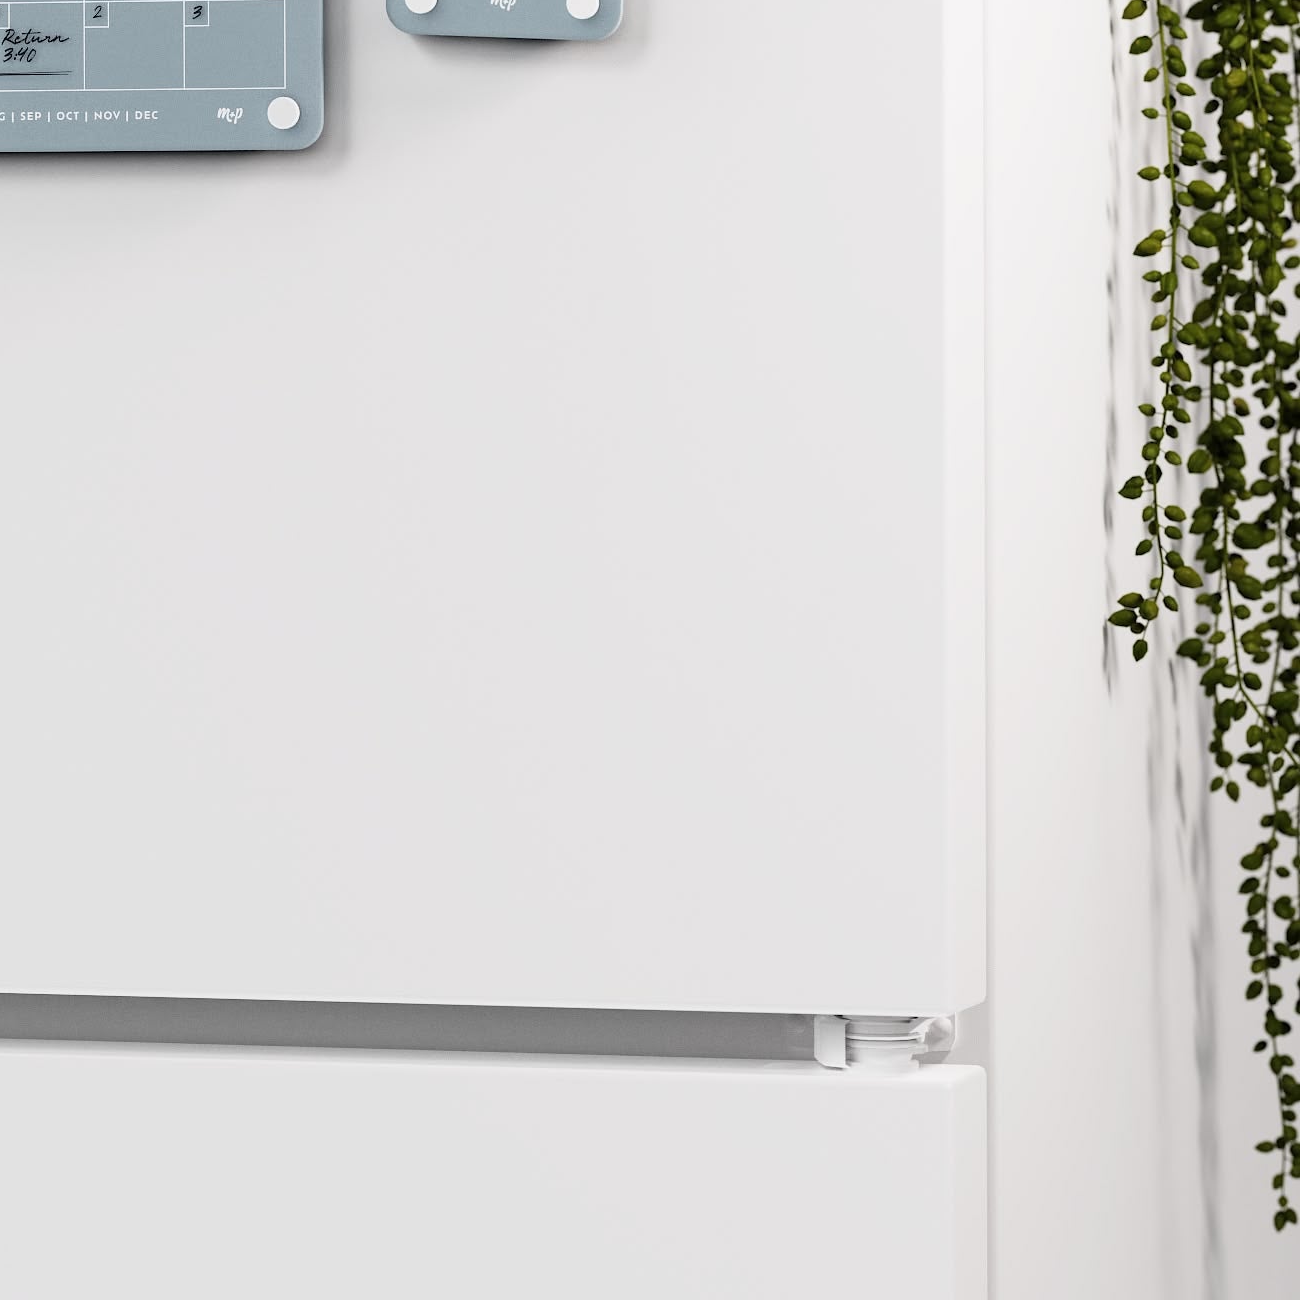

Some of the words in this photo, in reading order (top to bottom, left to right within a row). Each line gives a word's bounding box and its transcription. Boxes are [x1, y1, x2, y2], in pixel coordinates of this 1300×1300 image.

[93, 6, 102, 19] 2
[192, 6, 203, 20] 3
[1, 29, 70, 45] Return
[3, 47, 36, 63] 3:40
[20, 111, 42, 121] SEP
[56, 111, 79, 121] OCT
[94, 111, 120, 121] NOV
[135, 110, 158, 120] DEC
